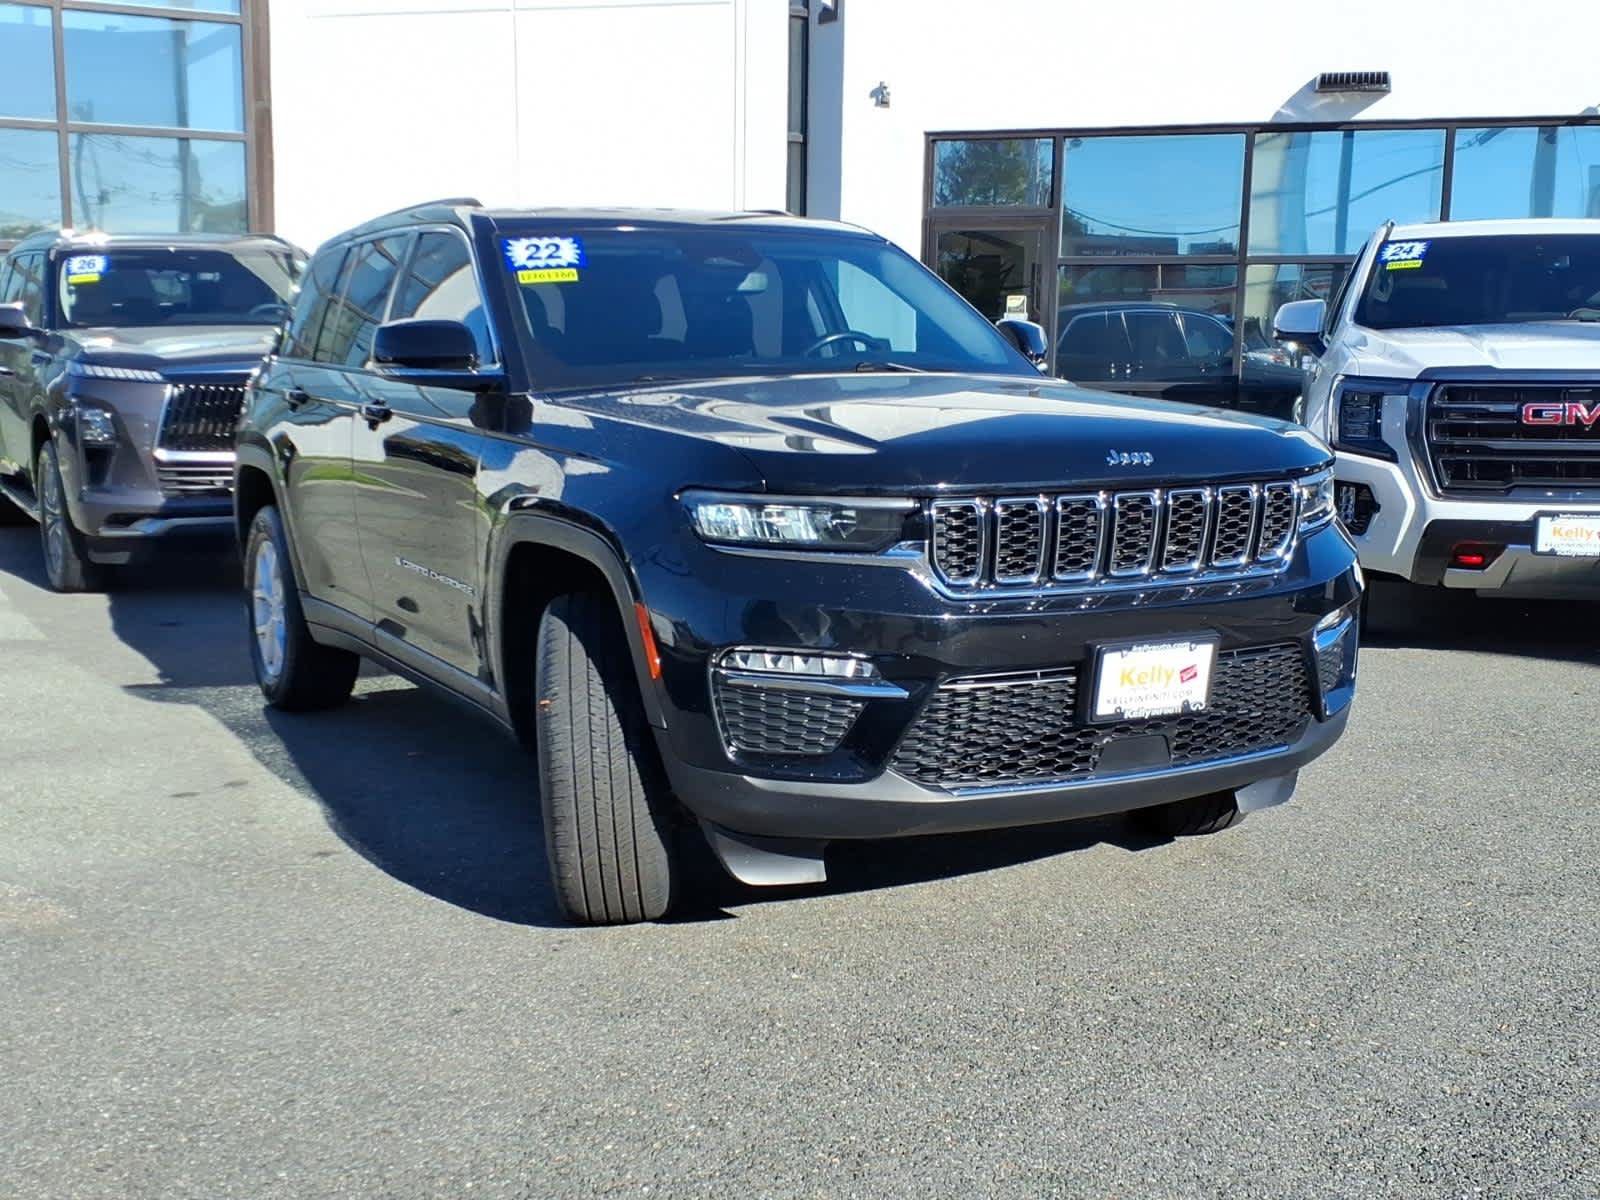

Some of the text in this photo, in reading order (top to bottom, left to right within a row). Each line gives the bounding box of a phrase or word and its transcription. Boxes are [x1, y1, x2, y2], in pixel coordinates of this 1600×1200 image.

[525, 243, 562, 261] 22
[1390, 245, 1415, 257] 24
[77, 259, 96, 270] 26
[1106, 449, 1154, 466] Jeep
[1552, 527, 1594, 542] Kelly
[1120, 664, 1175, 688] Kelly
